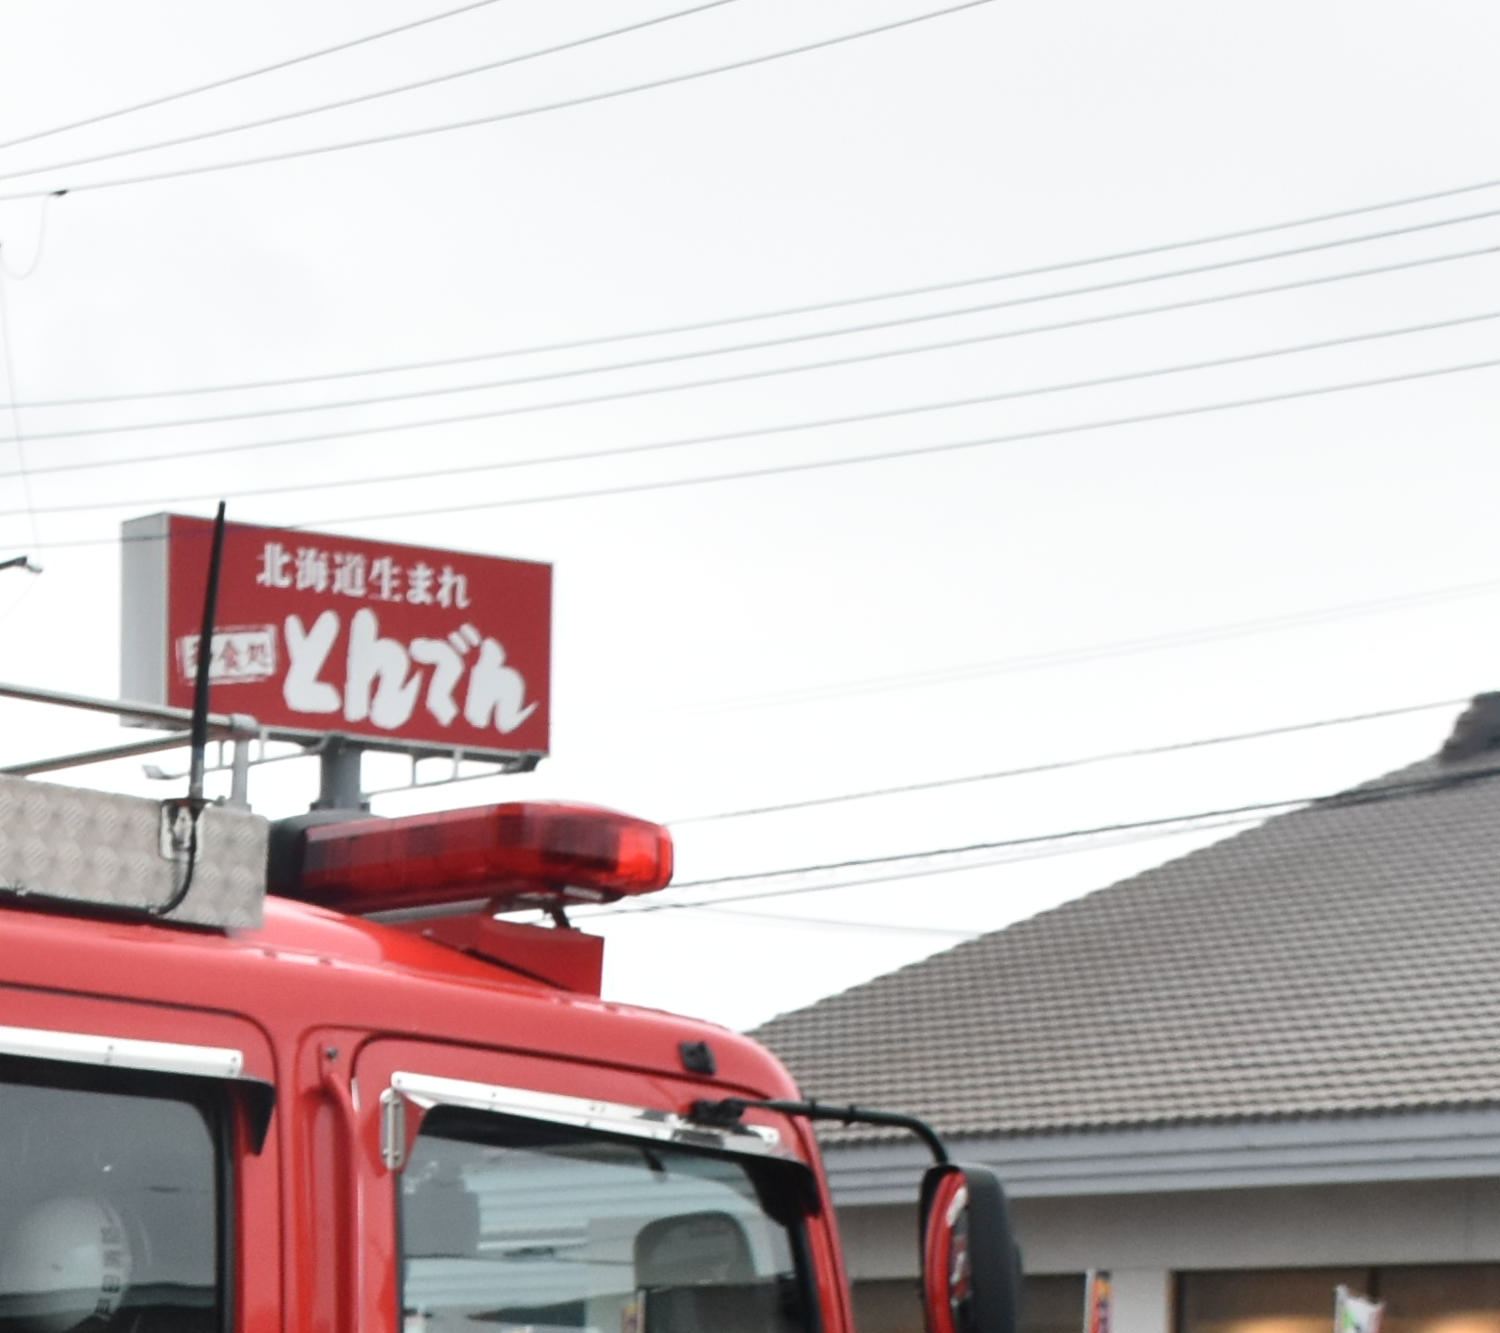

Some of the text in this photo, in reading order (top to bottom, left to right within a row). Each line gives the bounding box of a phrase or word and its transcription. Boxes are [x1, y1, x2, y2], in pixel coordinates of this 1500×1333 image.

[256, 542, 472, 609] 北海道生まれ
[282, 607, 538, 733] とんでん
